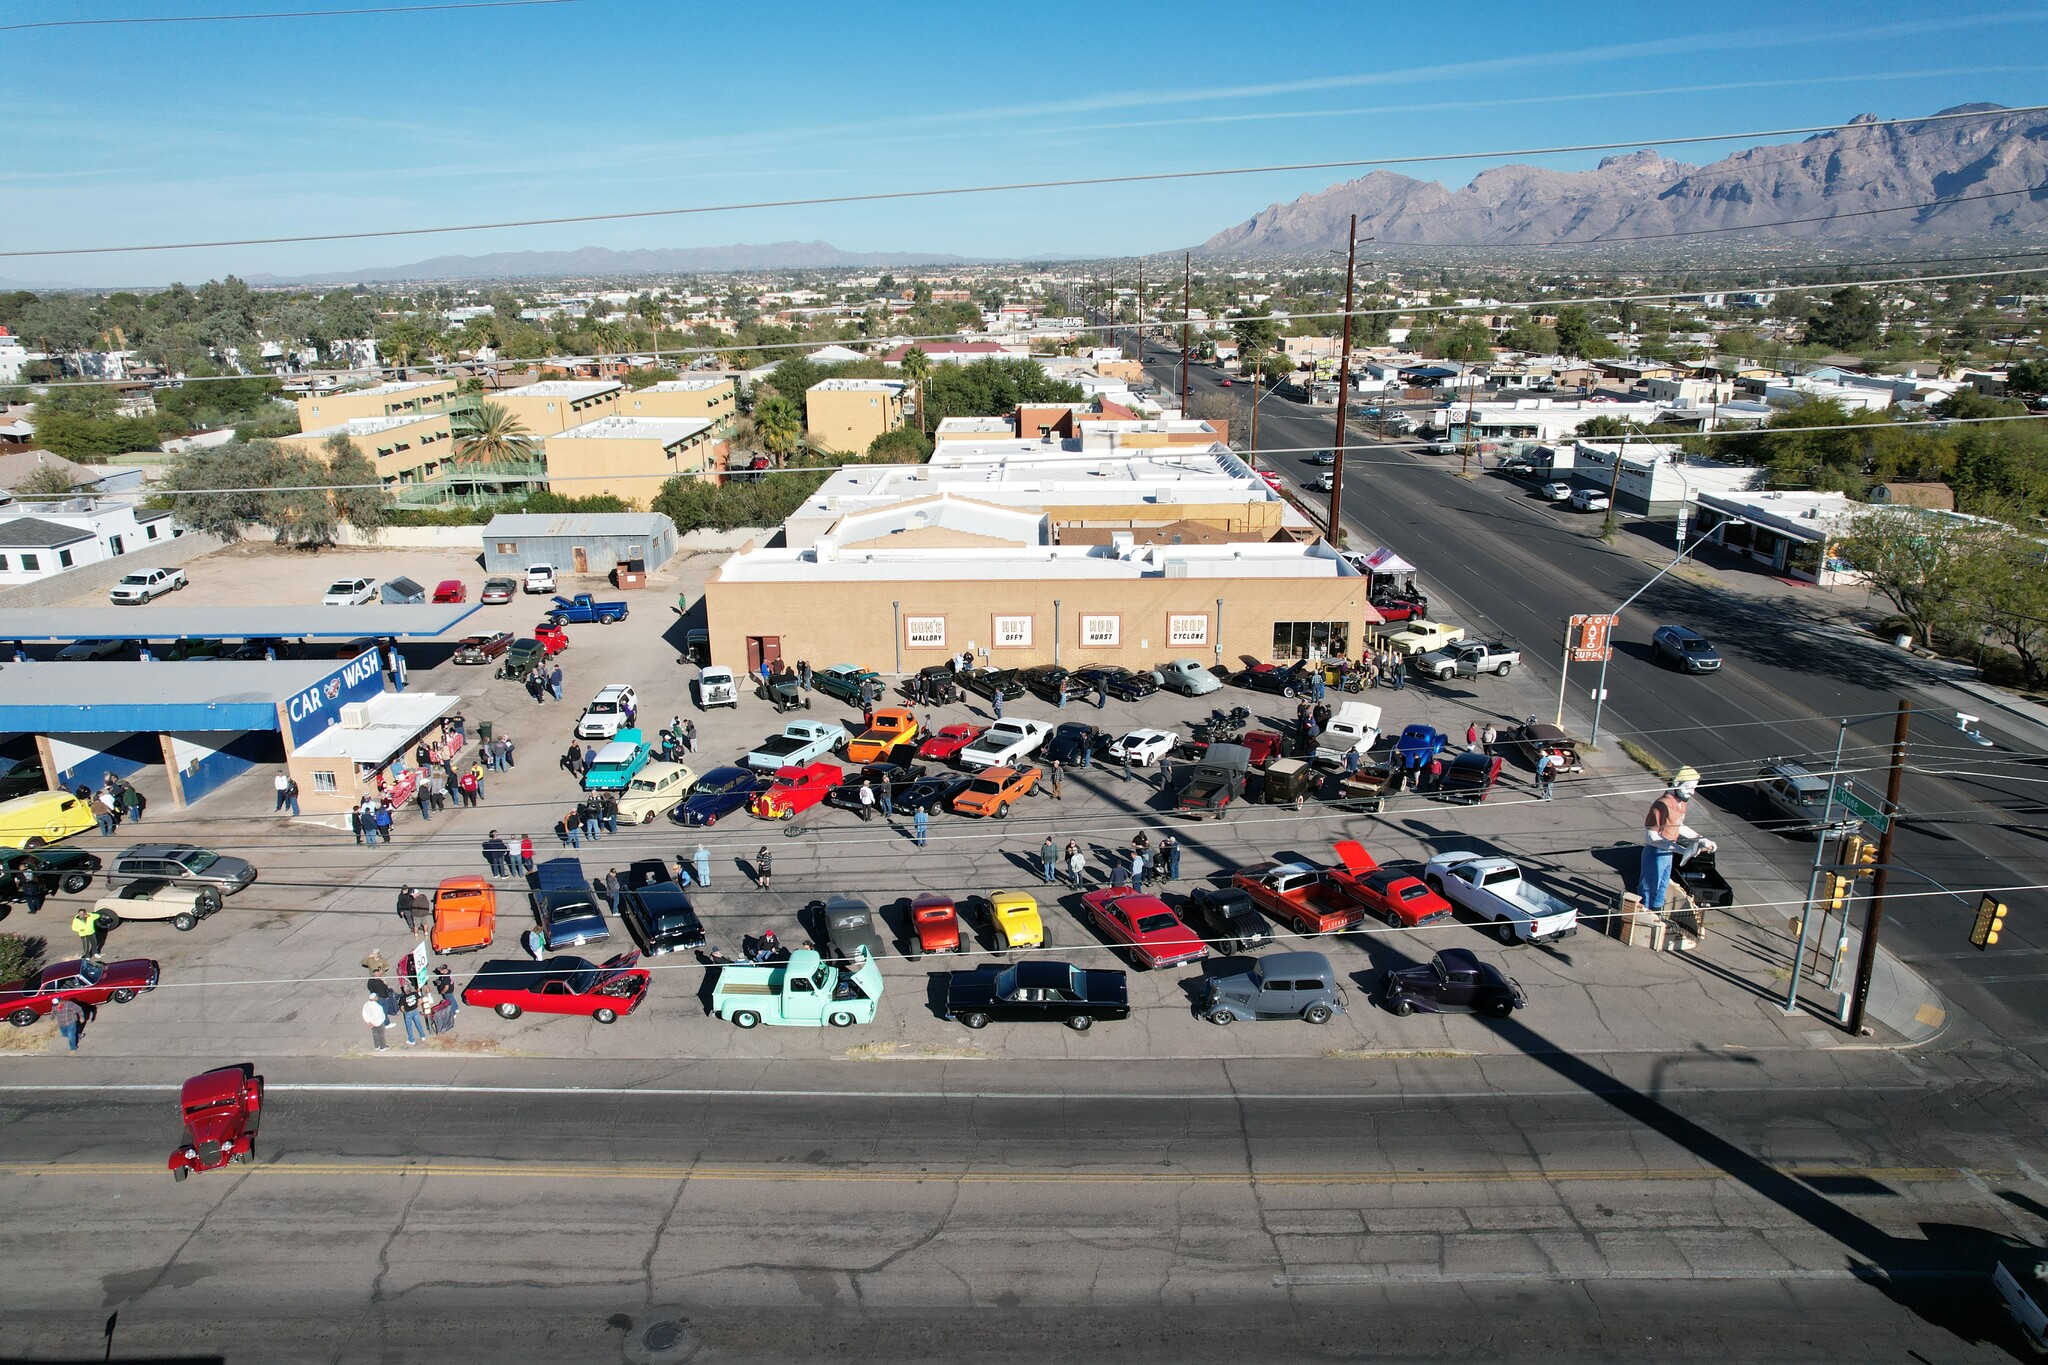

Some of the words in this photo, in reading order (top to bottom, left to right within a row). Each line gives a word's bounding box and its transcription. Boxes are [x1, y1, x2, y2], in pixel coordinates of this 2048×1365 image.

[911, 619, 943, 633] DON'S
[1002, 621, 1026, 633] HOT
[1089, 620, 1114, 632] ROD
[1173, 619, 1205, 632] SHOP
[911, 634, 942, 642] MALLORY
[1586, 625, 1598, 649] AUTO
[290, 687, 323, 722] CAR
[342, 651, 379, 689] WASH
[1840, 791, 1859, 811] Stone
[416, 956, 426, 970] 30
